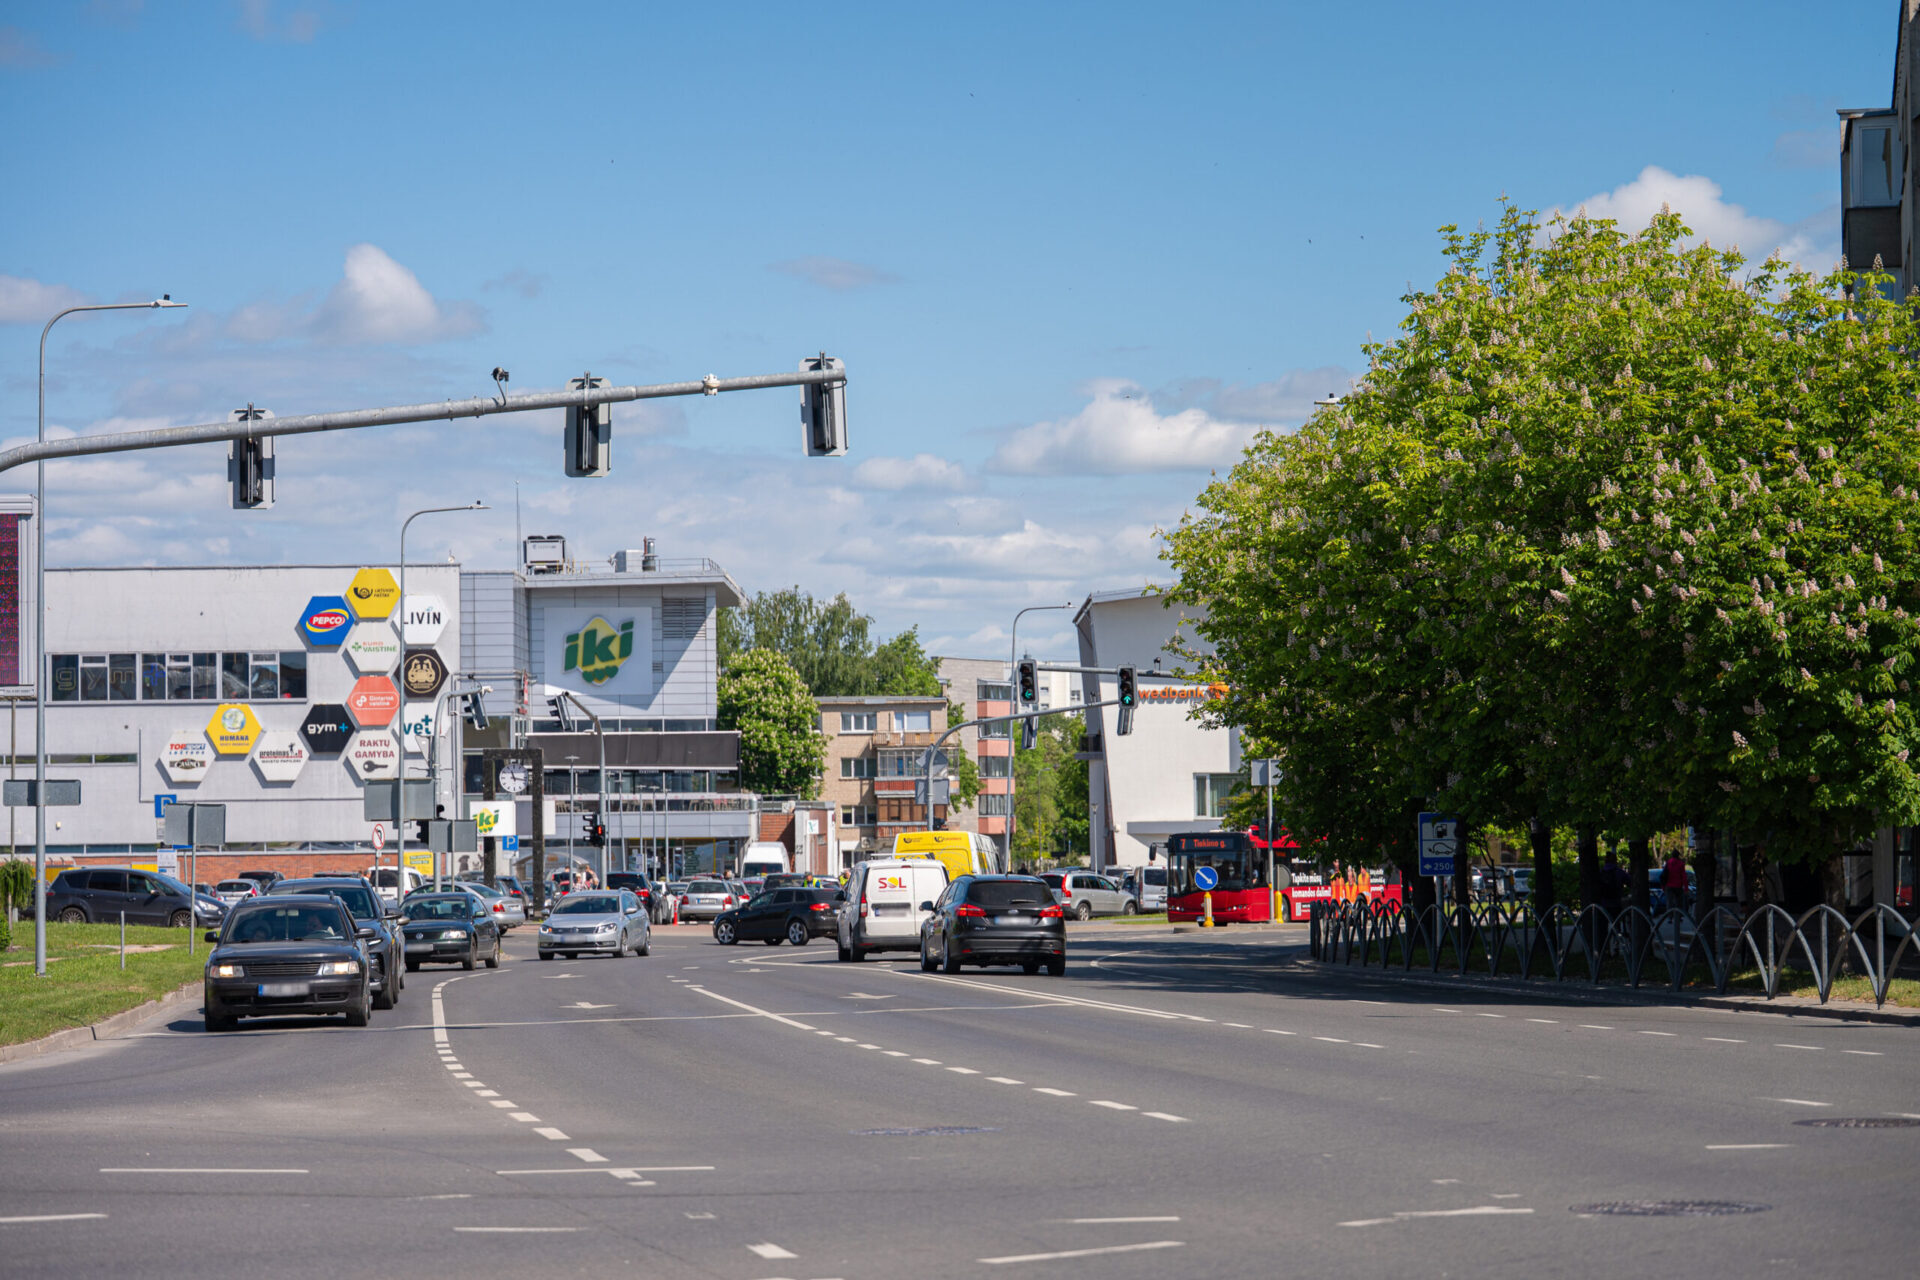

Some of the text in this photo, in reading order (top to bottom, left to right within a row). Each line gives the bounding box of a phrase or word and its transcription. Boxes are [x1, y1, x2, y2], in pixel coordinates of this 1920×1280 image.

[312, 616, 343, 626] PEPCO
[1138, 686, 1205, 699] wedbank
[359, 739, 391, 748] RAKTŲ
[354, 750, 395, 759] GAMYBA
[506, 836, 516, 849] P
[1180, 838, 1186, 850] 7
